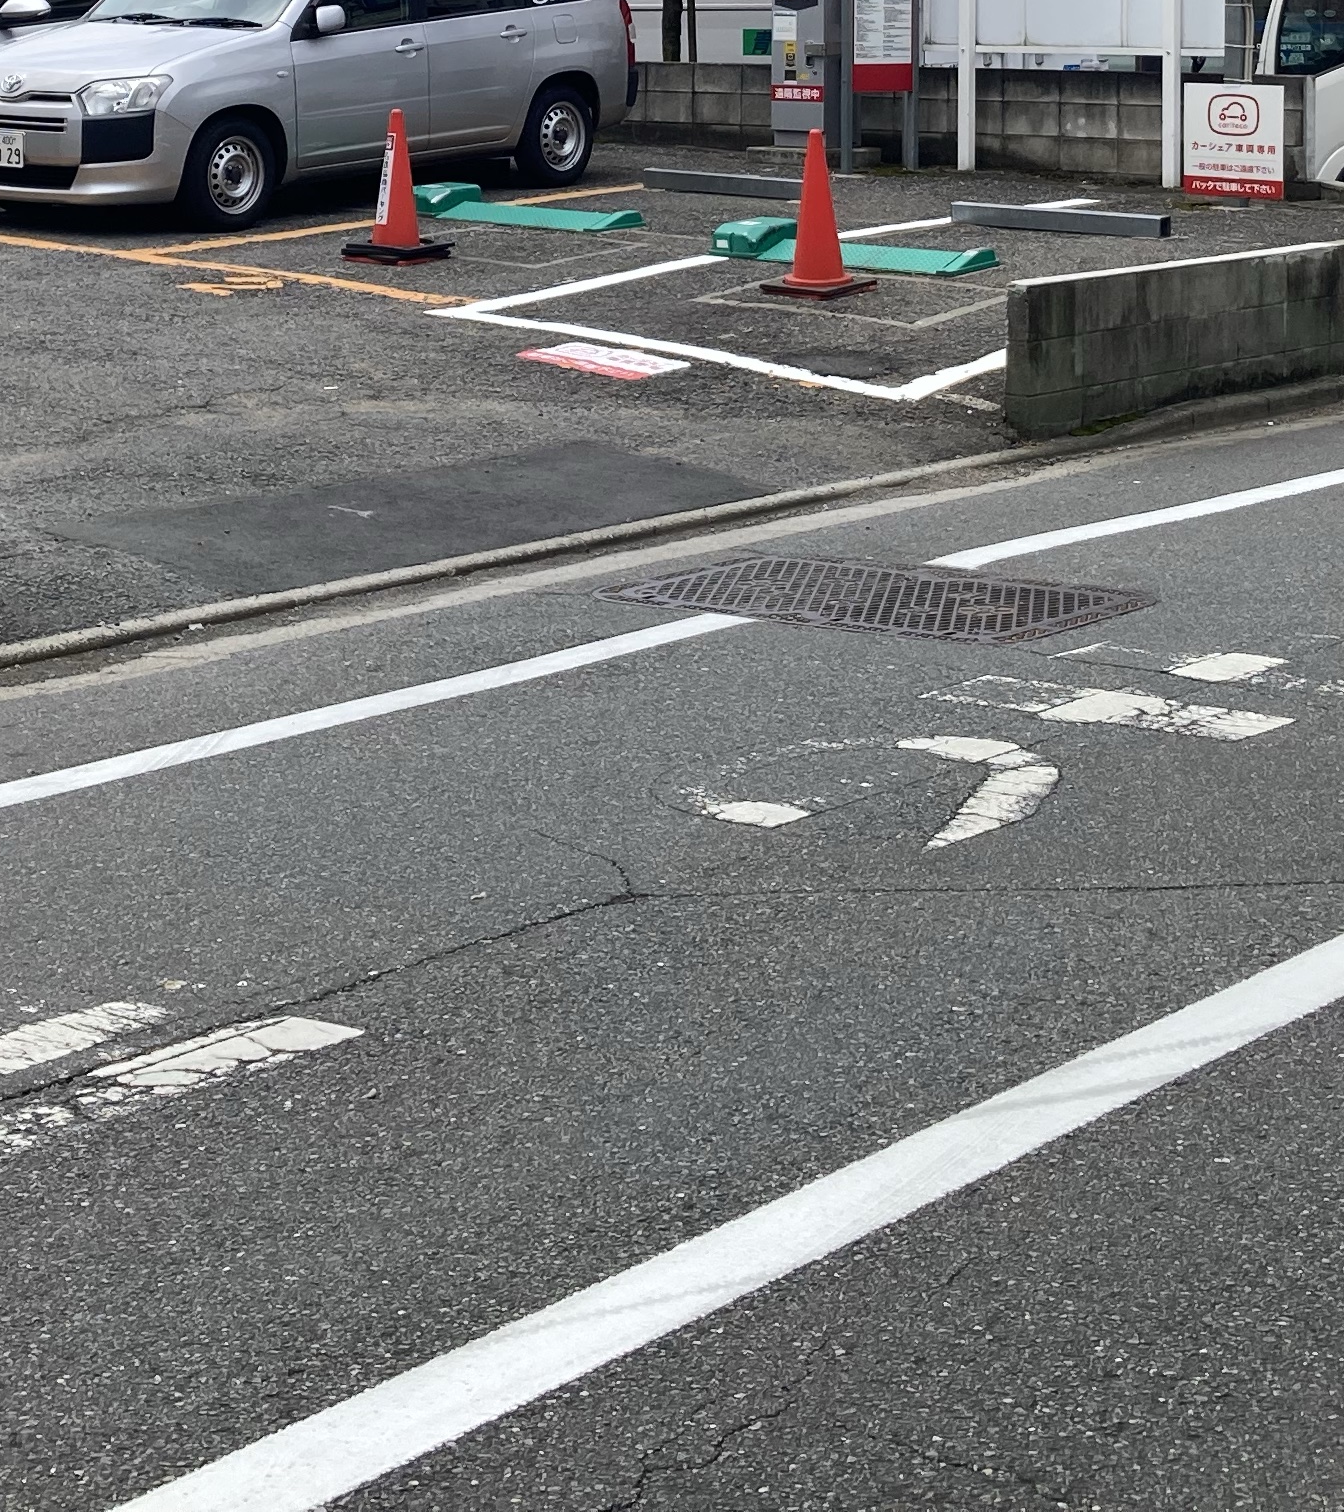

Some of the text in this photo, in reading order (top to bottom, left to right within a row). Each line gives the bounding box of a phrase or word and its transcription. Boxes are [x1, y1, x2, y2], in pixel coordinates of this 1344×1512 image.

[1191, 141, 1276, 155] カーシェア車両専用
[1191, 162, 1276, 174] 一般の駐車はご遠慮下さい
[1191, 180, 1276, 194] バックで駐車して下さい
